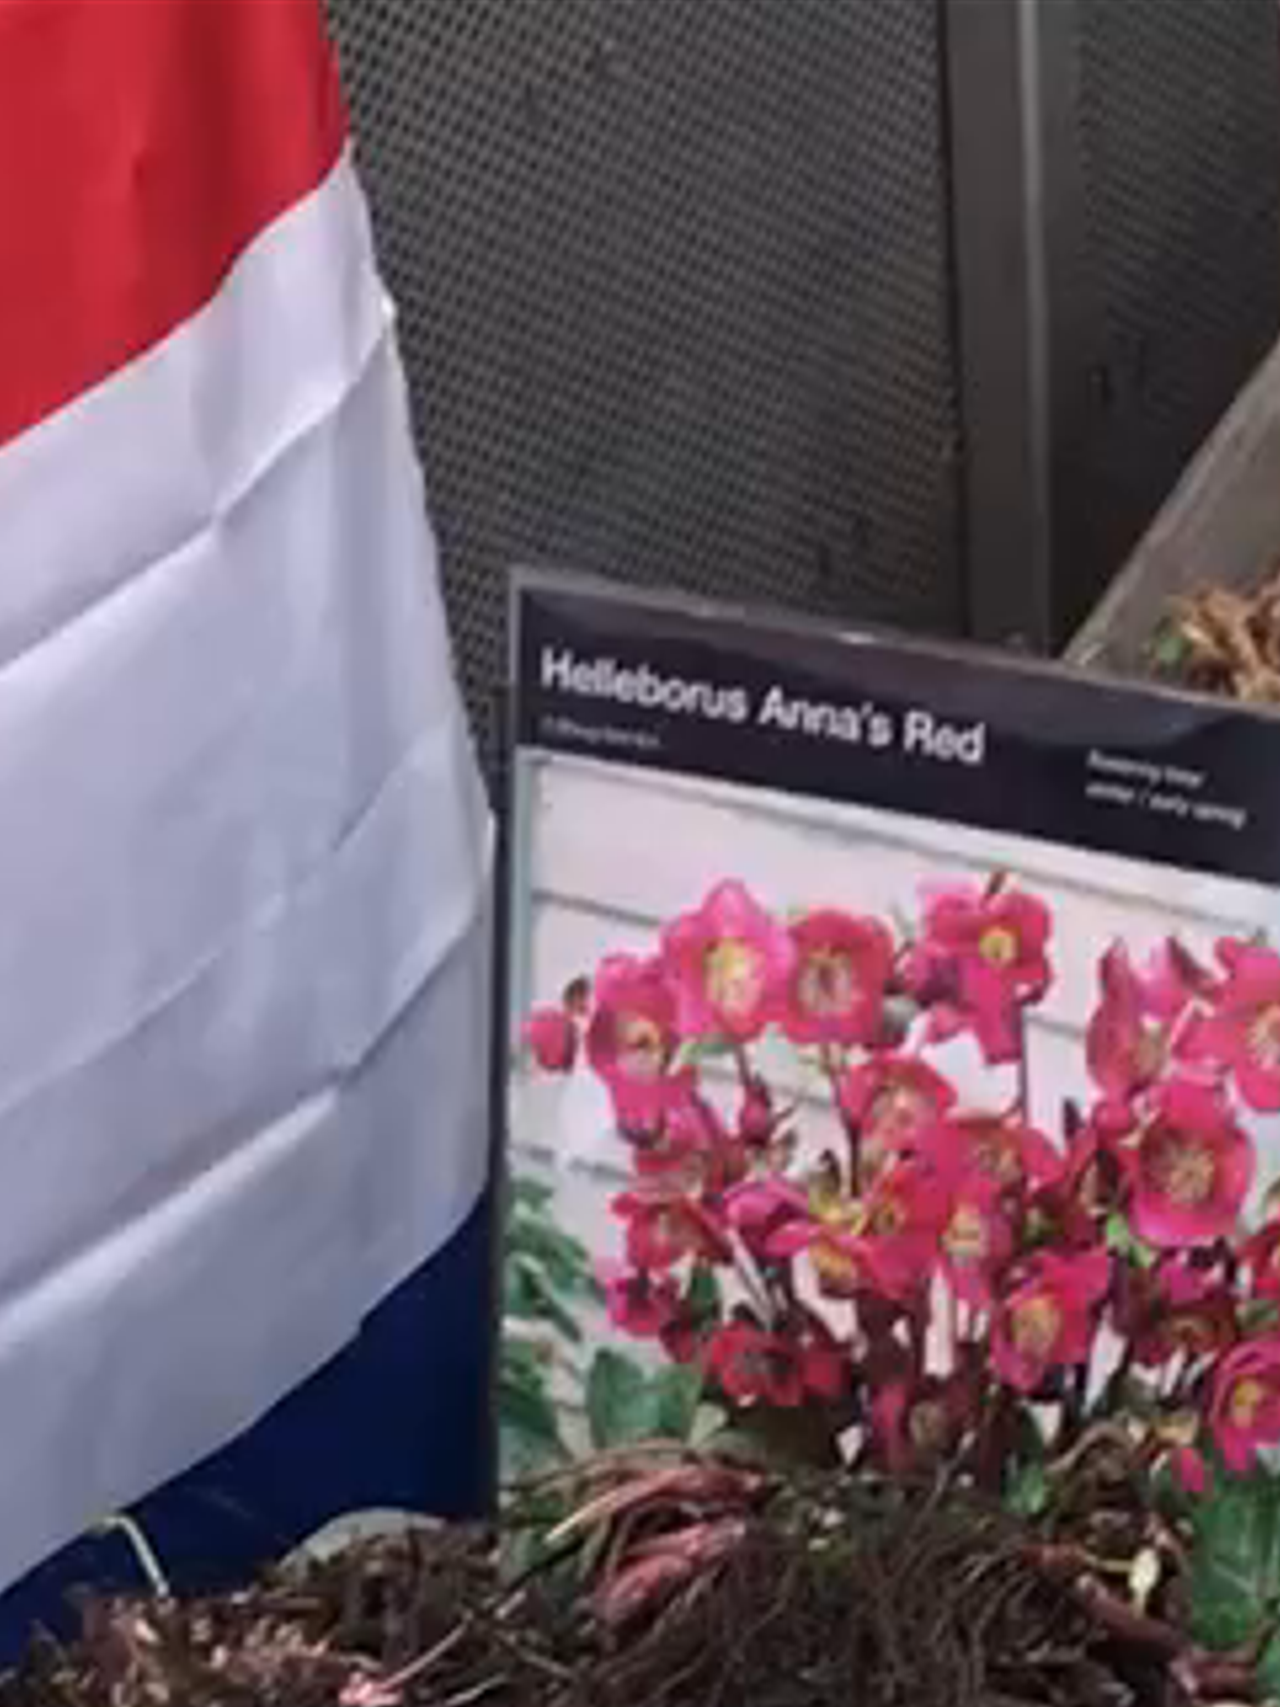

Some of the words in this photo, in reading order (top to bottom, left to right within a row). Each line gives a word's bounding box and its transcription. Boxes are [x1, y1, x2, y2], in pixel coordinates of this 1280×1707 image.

[540, 646, 748, 723] Helleborus
[757, 687, 892, 747] Anna's
[903, 710, 987, 766] Red
